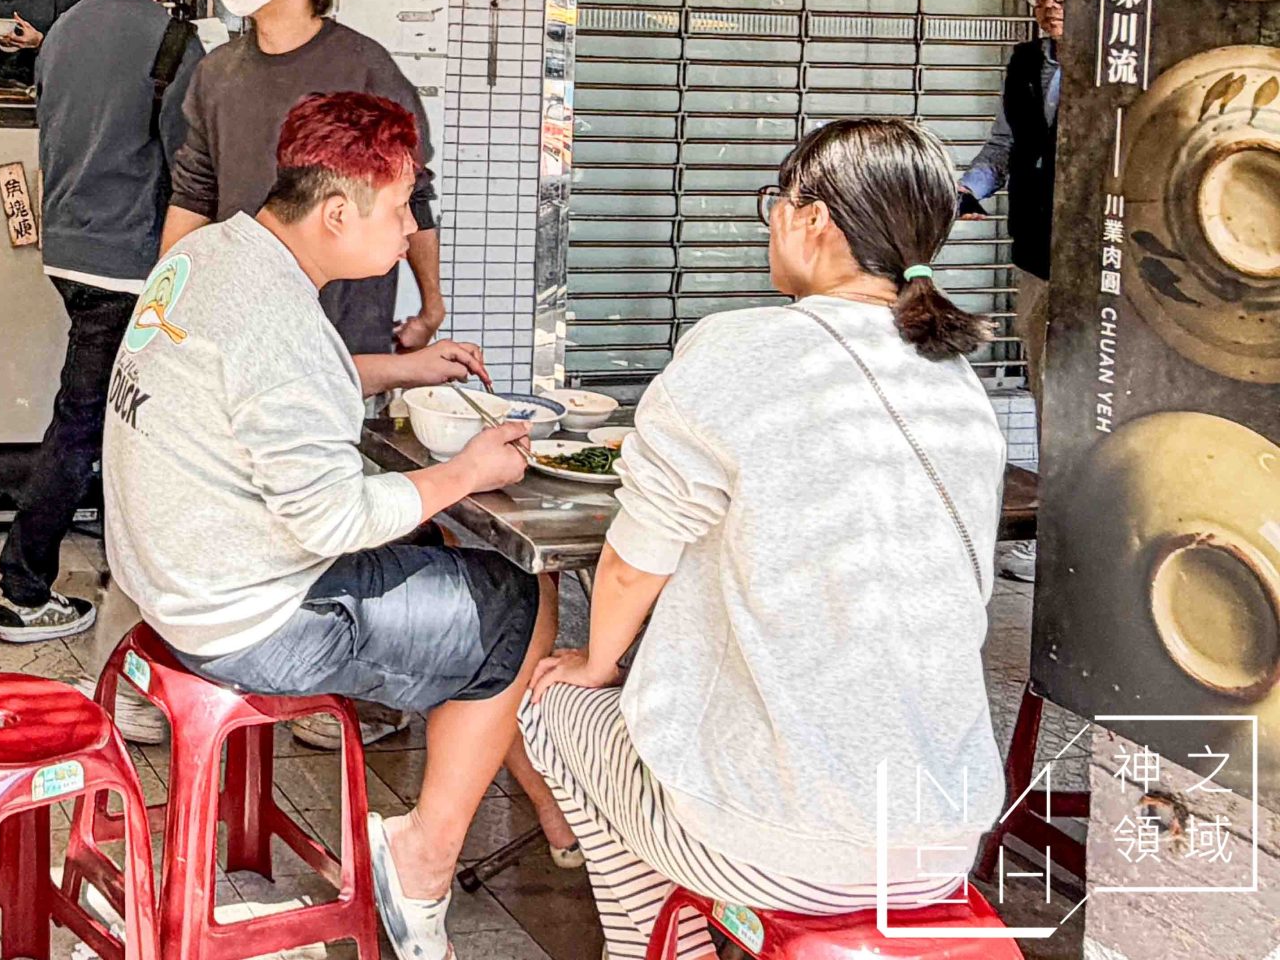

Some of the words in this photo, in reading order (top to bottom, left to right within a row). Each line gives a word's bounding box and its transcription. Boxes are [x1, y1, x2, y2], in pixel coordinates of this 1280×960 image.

[1100, 193, 1125, 296] 川業肉圓
[1097, 306, 1118, 385] CHUAN
[1094, 392, 1114, 434] YEH
